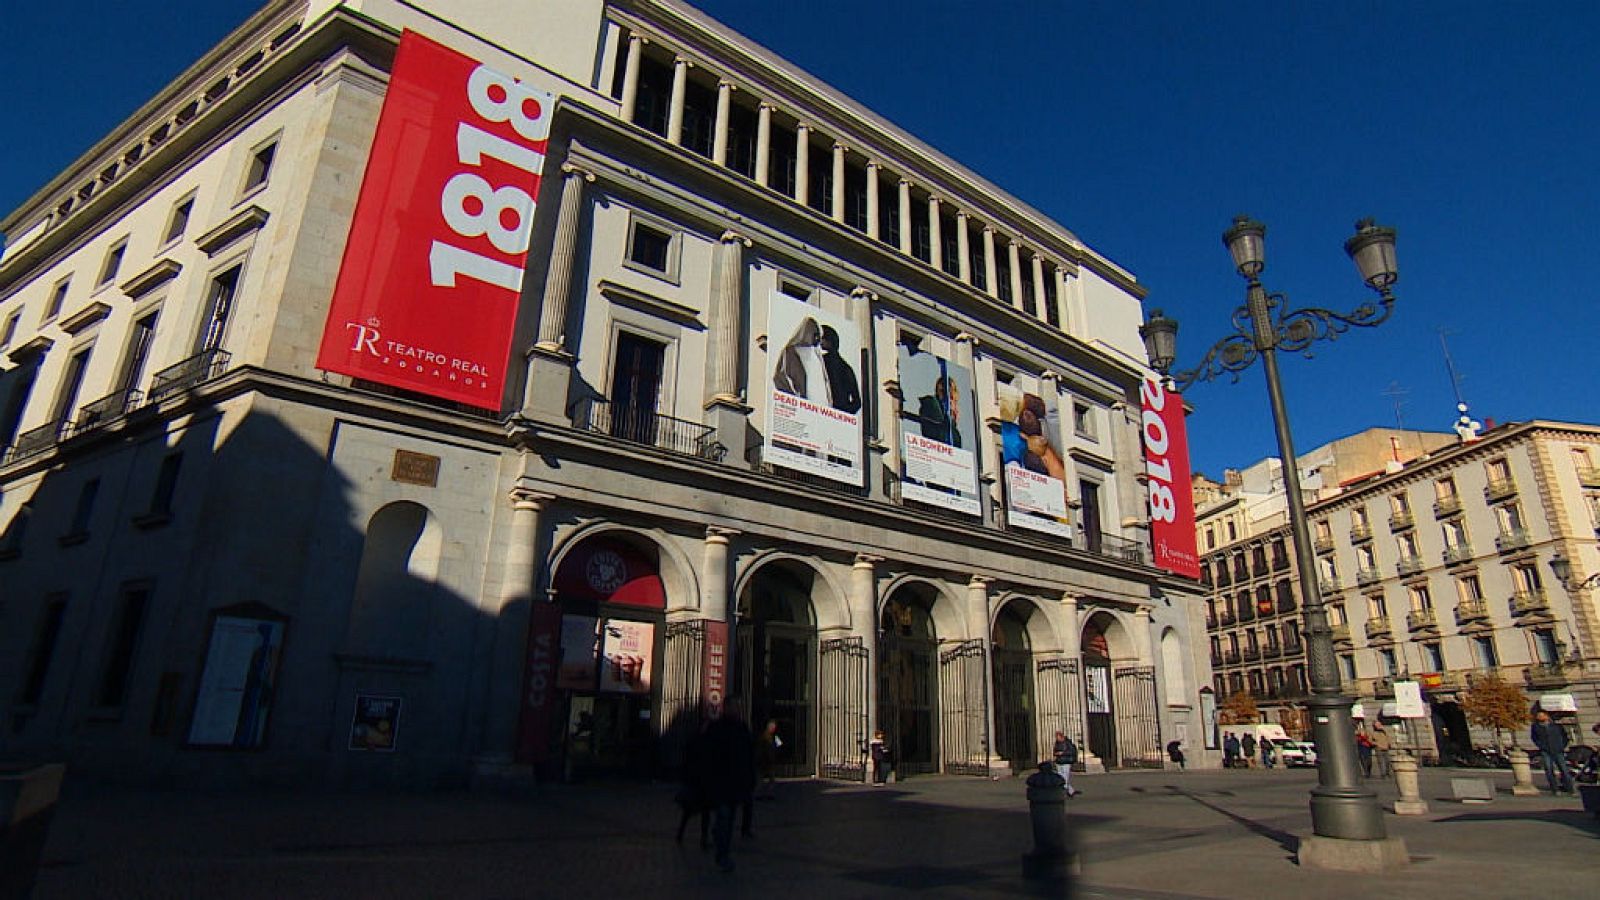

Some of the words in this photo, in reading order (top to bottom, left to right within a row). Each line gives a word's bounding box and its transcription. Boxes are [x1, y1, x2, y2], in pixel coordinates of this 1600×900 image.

[429, 63, 555, 292] 1818
[387, 341, 447, 365] TEATRO
[452, 358, 489, 377] REAL
[773, 392, 798, 407] DEAD
[819, 406, 857, 426] WALKING
[1139, 372, 1176, 523] 2018
[528, 632, 551, 707] COSTA
[707, 643, 723, 720] COFFEE
